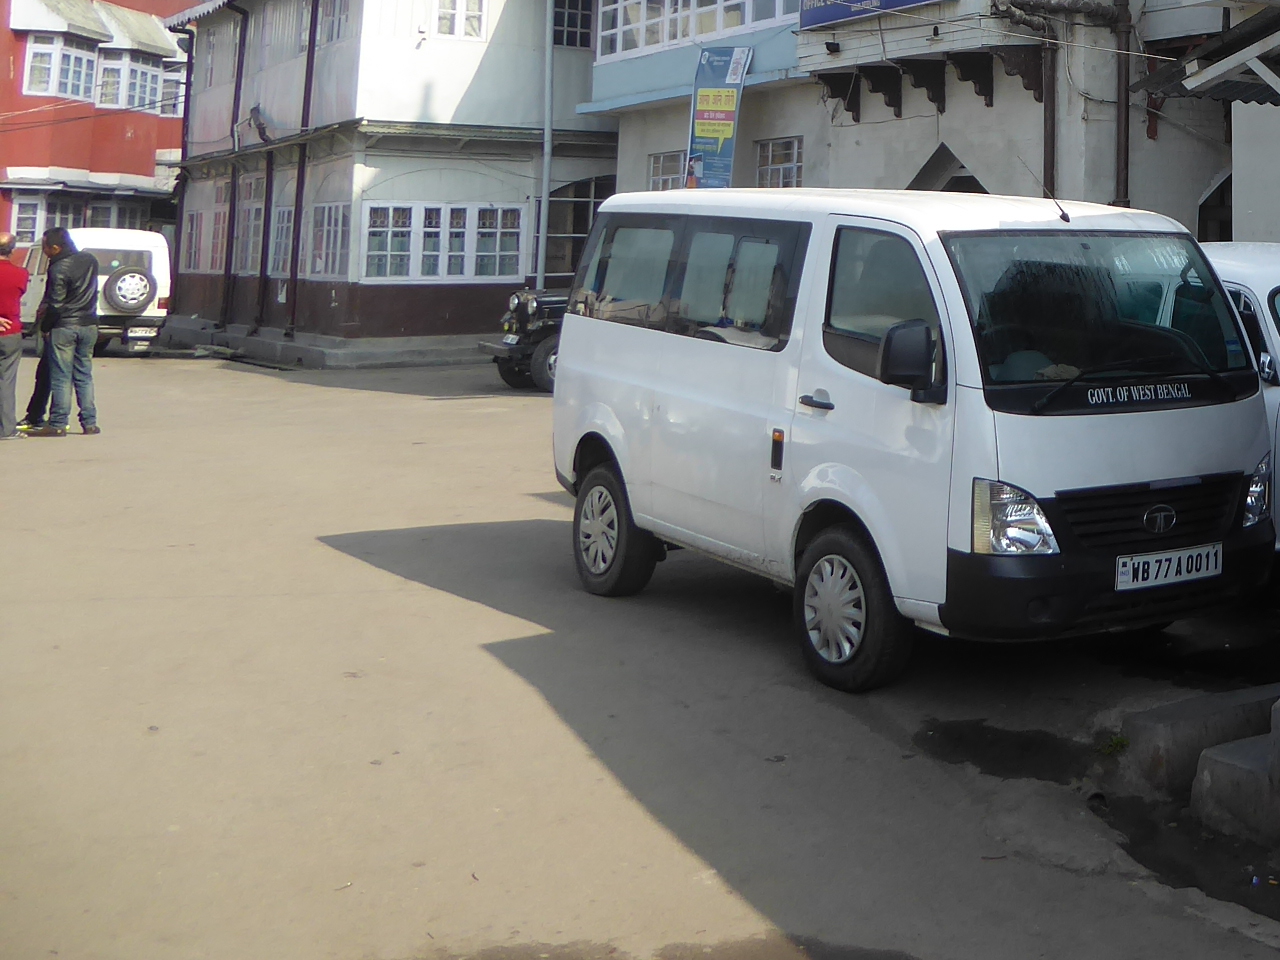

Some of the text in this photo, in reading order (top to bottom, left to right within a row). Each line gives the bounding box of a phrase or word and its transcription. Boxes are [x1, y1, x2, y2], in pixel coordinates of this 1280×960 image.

[1087, 382, 1192, 405] GOVT. OF WEST BENGAL
